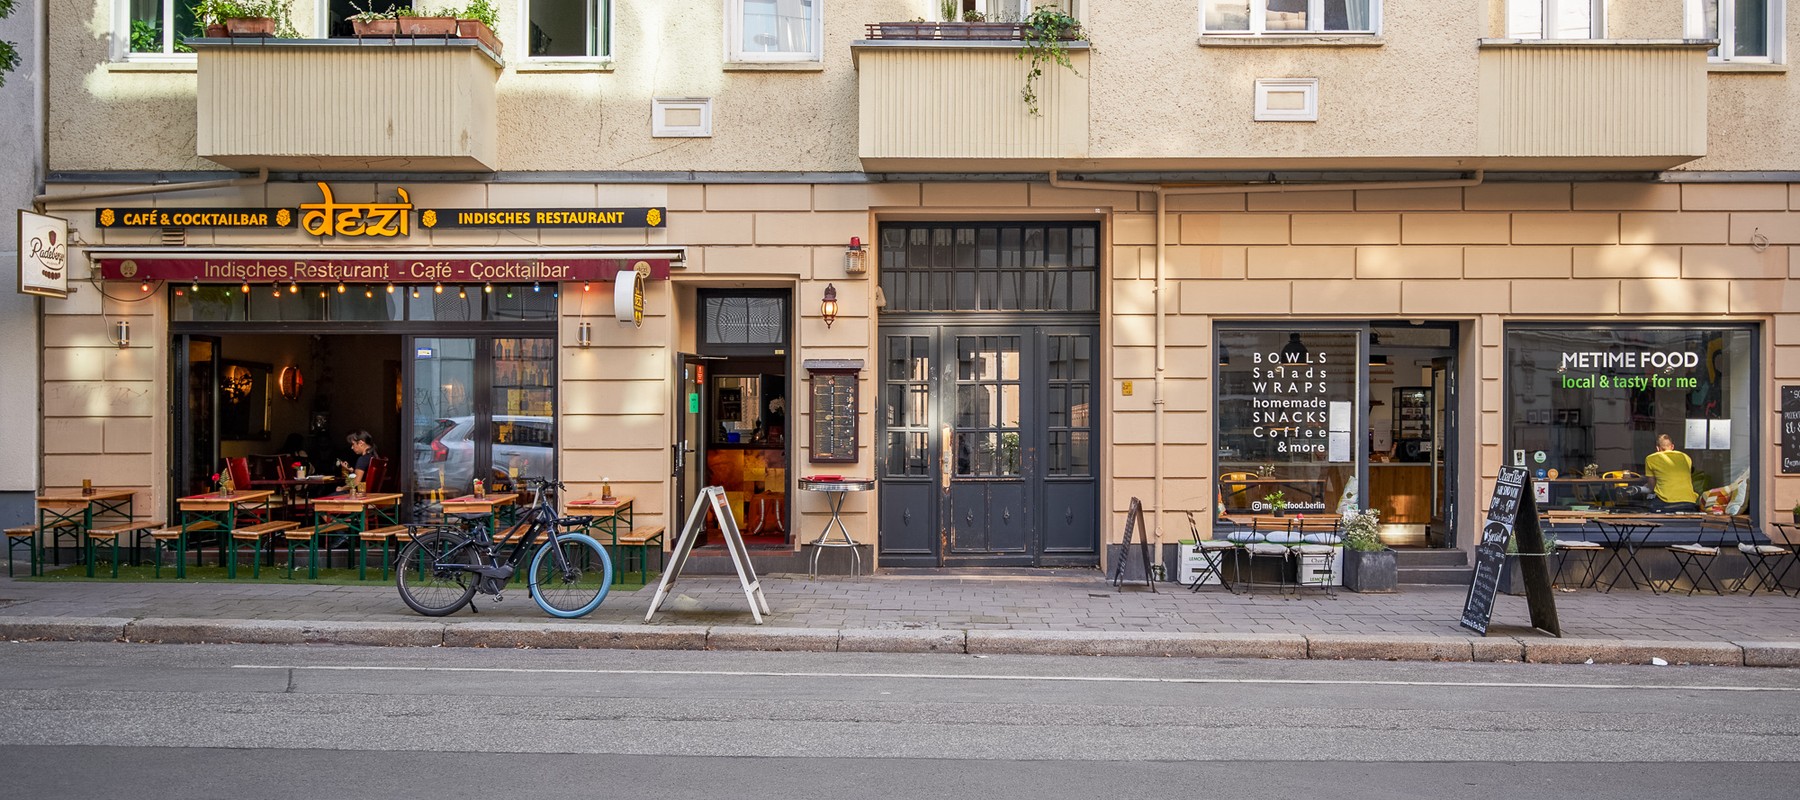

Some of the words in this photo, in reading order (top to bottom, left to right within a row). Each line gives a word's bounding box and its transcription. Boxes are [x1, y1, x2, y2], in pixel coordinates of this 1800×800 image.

[123, 209, 158, 226] CAFÉ
[160, 213, 171, 226] &
[173, 213, 268, 226] COCKTAILBAR
[458, 212, 531, 225] INDISCHES
[536, 211, 625, 224] RESTAURANT
[204, 261, 288, 278] Indisches
[294, 261, 389, 278] Restaurant
[411, 261, 452, 278] Café
[470, 261, 570, 278] Cocktailbar
[1253, 352, 1327, 364] BOWLS
[1562, 351, 1636, 368] METIME
[1640, 351, 1699, 368] FOOD
[1253, 367, 1327, 379] Salads
[1252, 382, 1327, 393] WRAPS
[1562, 374, 1595, 389] local
[1600, 375, 1610, 388] &
[1613, 375, 1649, 391] tasty
[1652, 374, 1673, 388] for
[1676, 377, 1697, 388] me
[1253, 397, 1327, 408] homemade
[1253, 411, 1327, 423] SNACKS
[1253, 426, 1327, 438] Coffee
[1262, 501, 1326, 509] meefood.berlin
